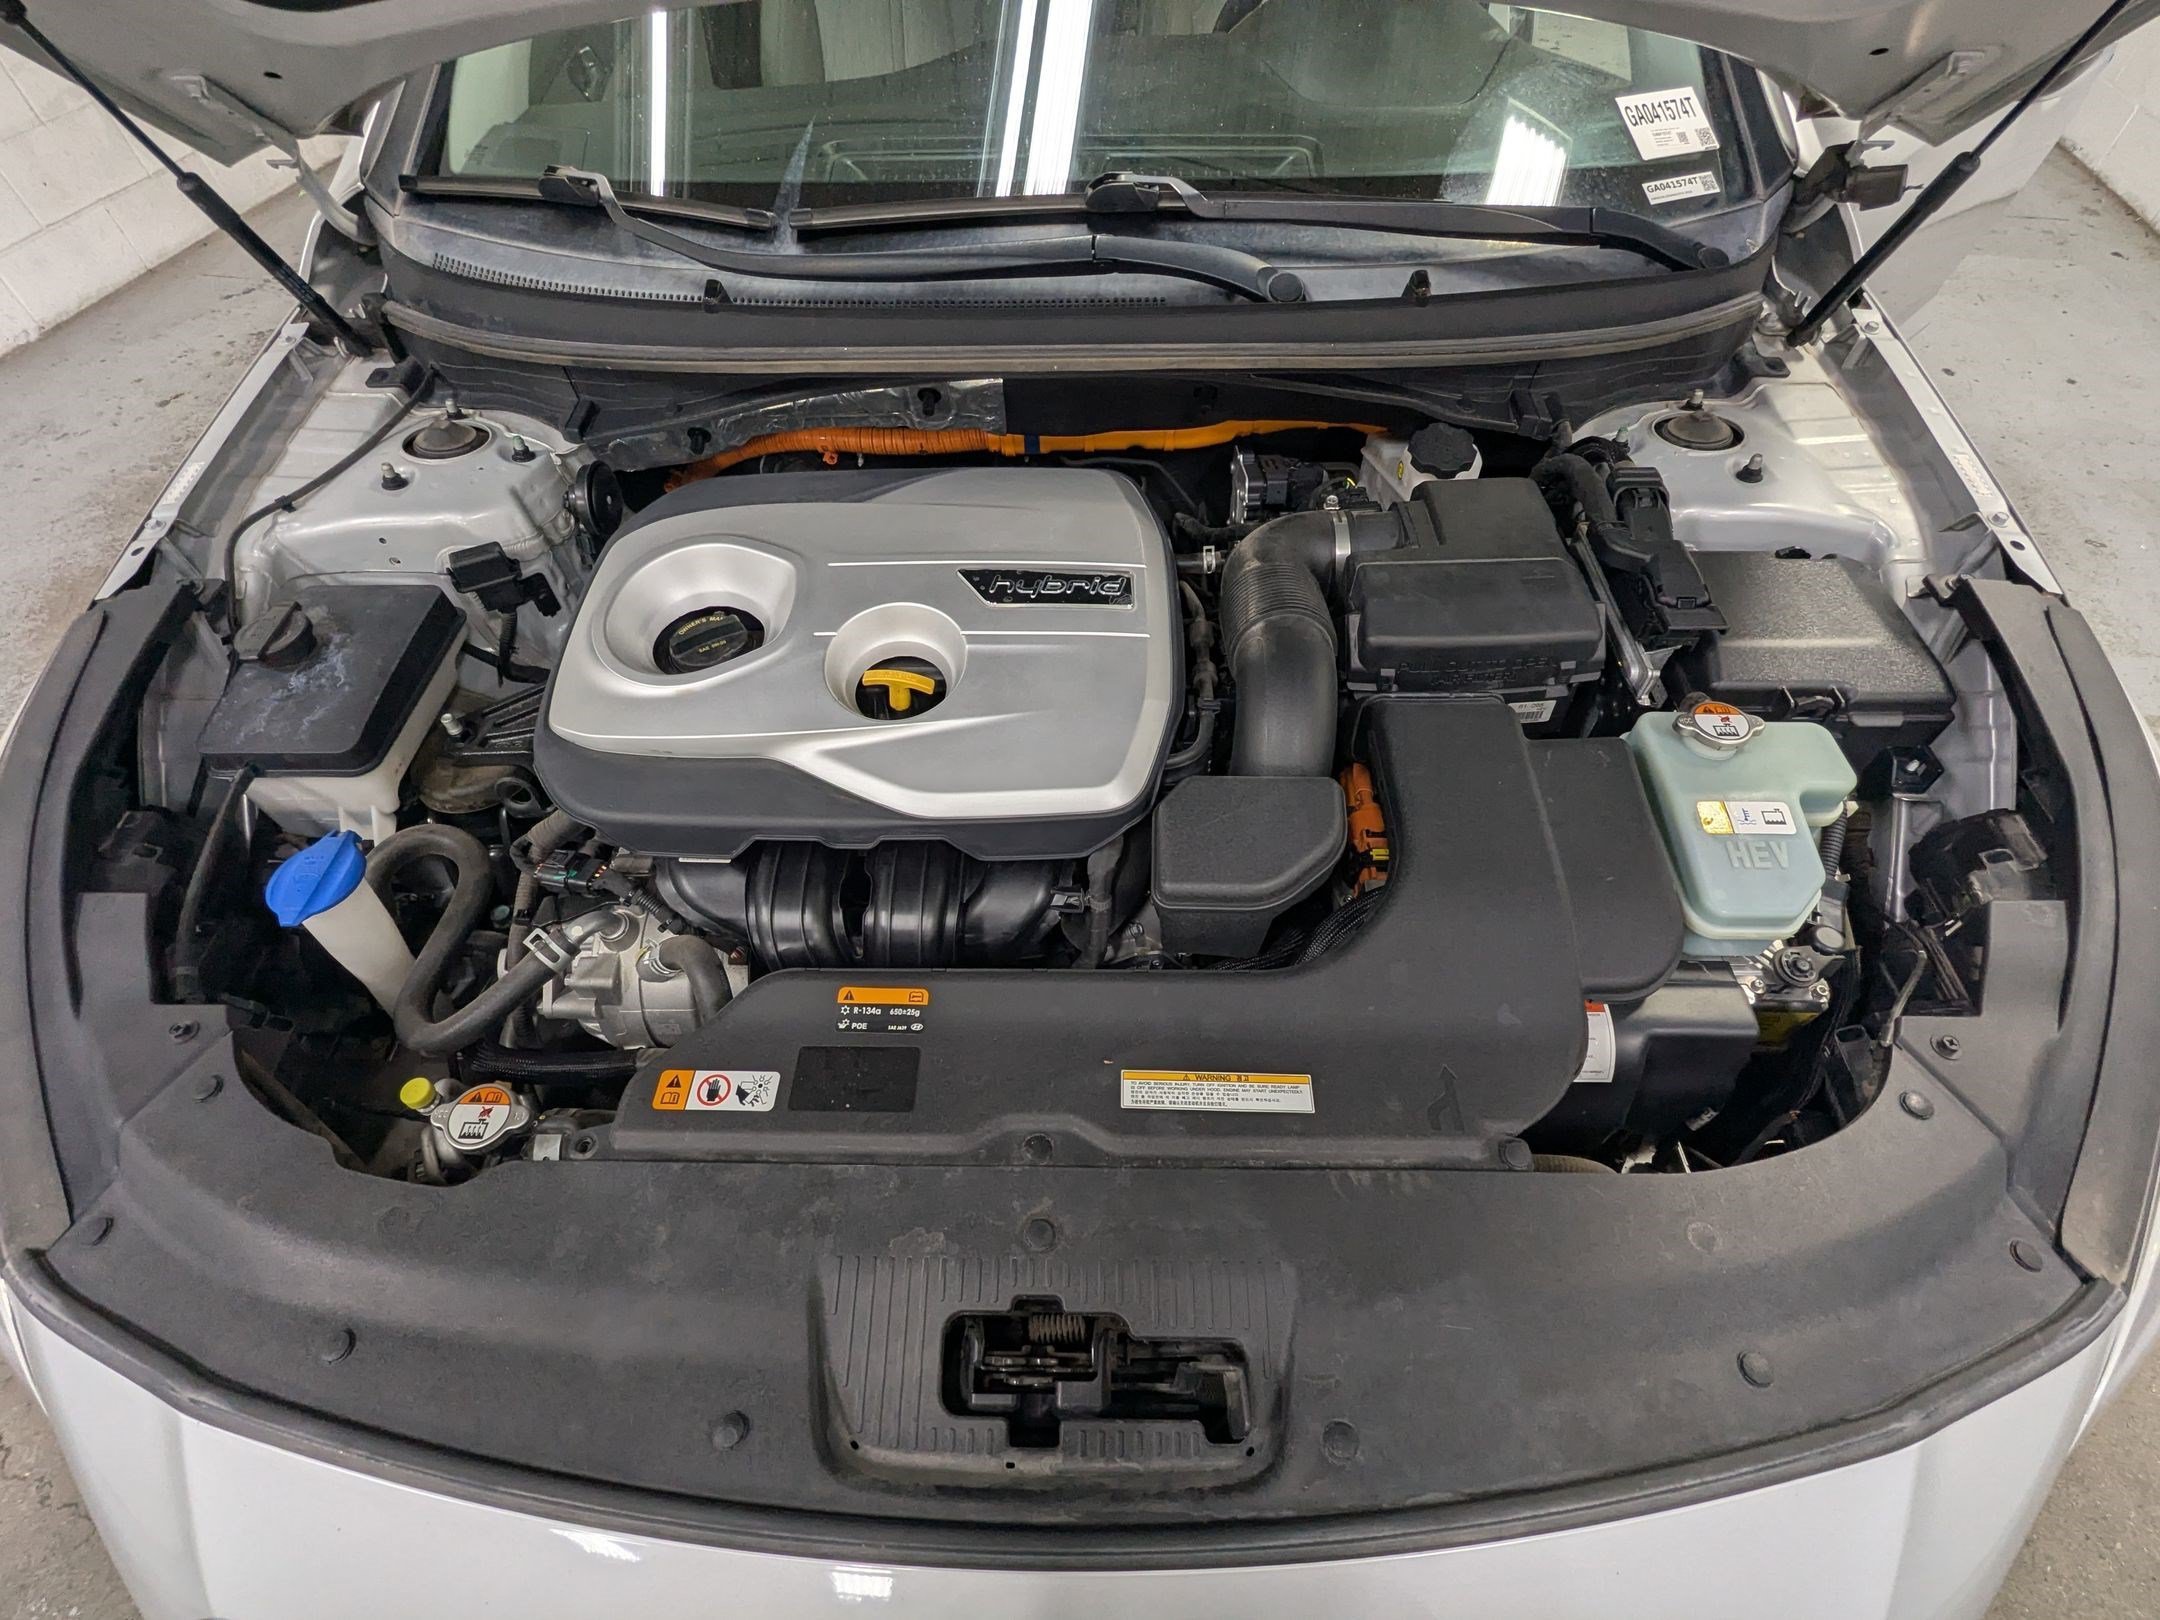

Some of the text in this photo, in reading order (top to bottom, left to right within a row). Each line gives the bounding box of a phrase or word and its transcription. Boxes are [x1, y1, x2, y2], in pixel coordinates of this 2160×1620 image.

[1624, 96, 1697, 127] GA041574T
[1646, 176, 1698, 194] GA041574T
[989, 575, 1127, 599] hybrid
[1725, 840, 1791, 870] HEV
[853, 1006, 921, 1017] R-134a 650±25g
[1195, 1074, 1231, 1082] WARNING
